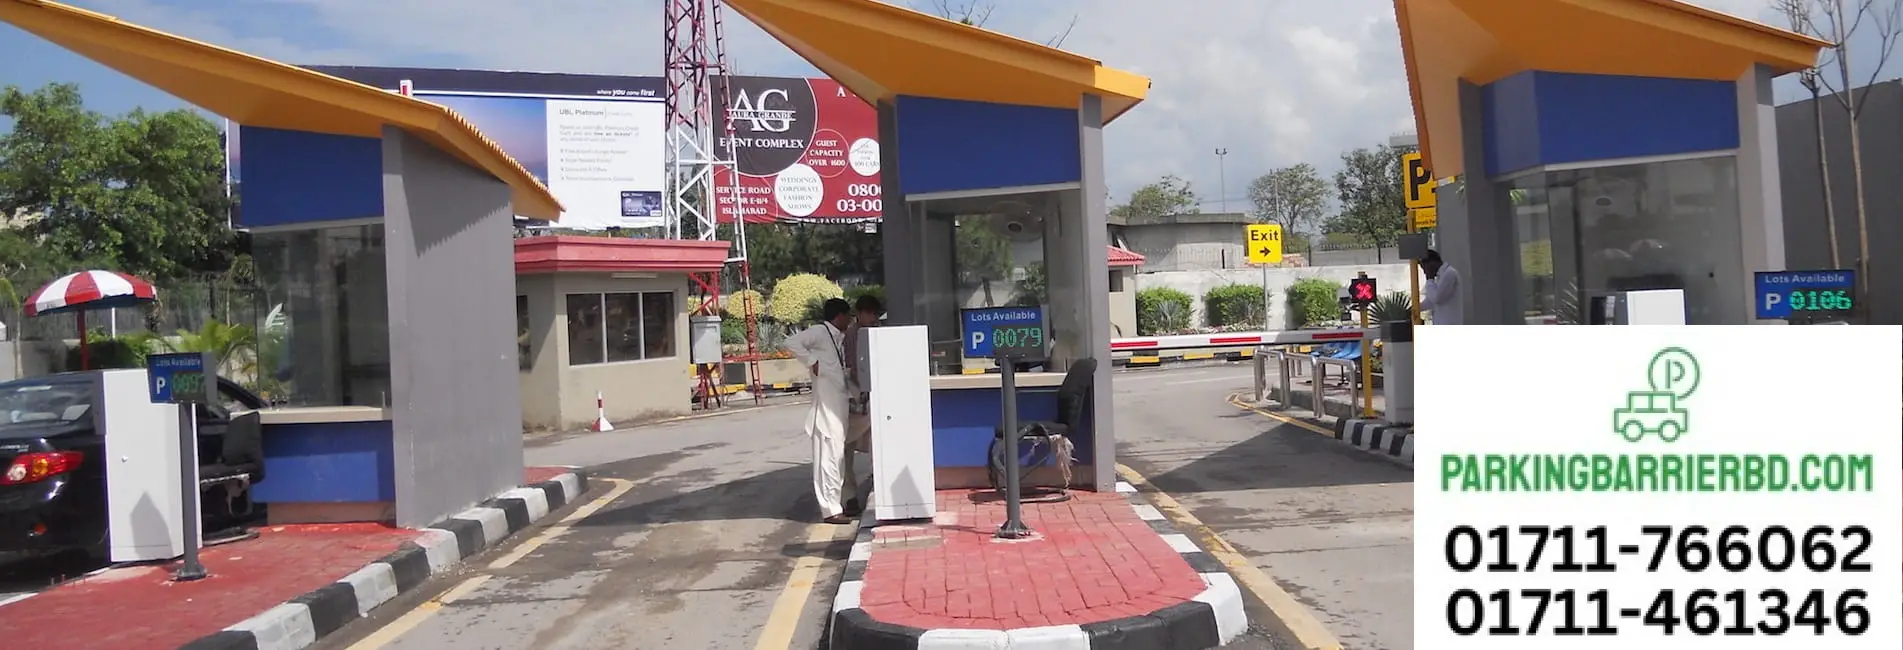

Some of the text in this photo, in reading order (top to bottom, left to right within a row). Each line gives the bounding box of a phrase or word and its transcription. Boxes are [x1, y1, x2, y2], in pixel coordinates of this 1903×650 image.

[612, 89, 626, 97] you
[640, 88, 655, 97] first
[837, 86, 846, 98] A
[727, 88, 791, 132] AG
[759, 111, 793, 120] GRANDE
[755, 138, 804, 149] COMPLEX
[809, 149, 843, 157] CAPACITY
[848, 184, 881, 197] 080
[1251, 229, 1279, 241] Exit
[1765, 273, 1845, 283] Lots Available
[1765, 290, 1852, 310] P 0106
[971, 311, 1036, 321] Lots Available
[972, 327, 1042, 350] P 0079
[156, 376, 166, 394] P
